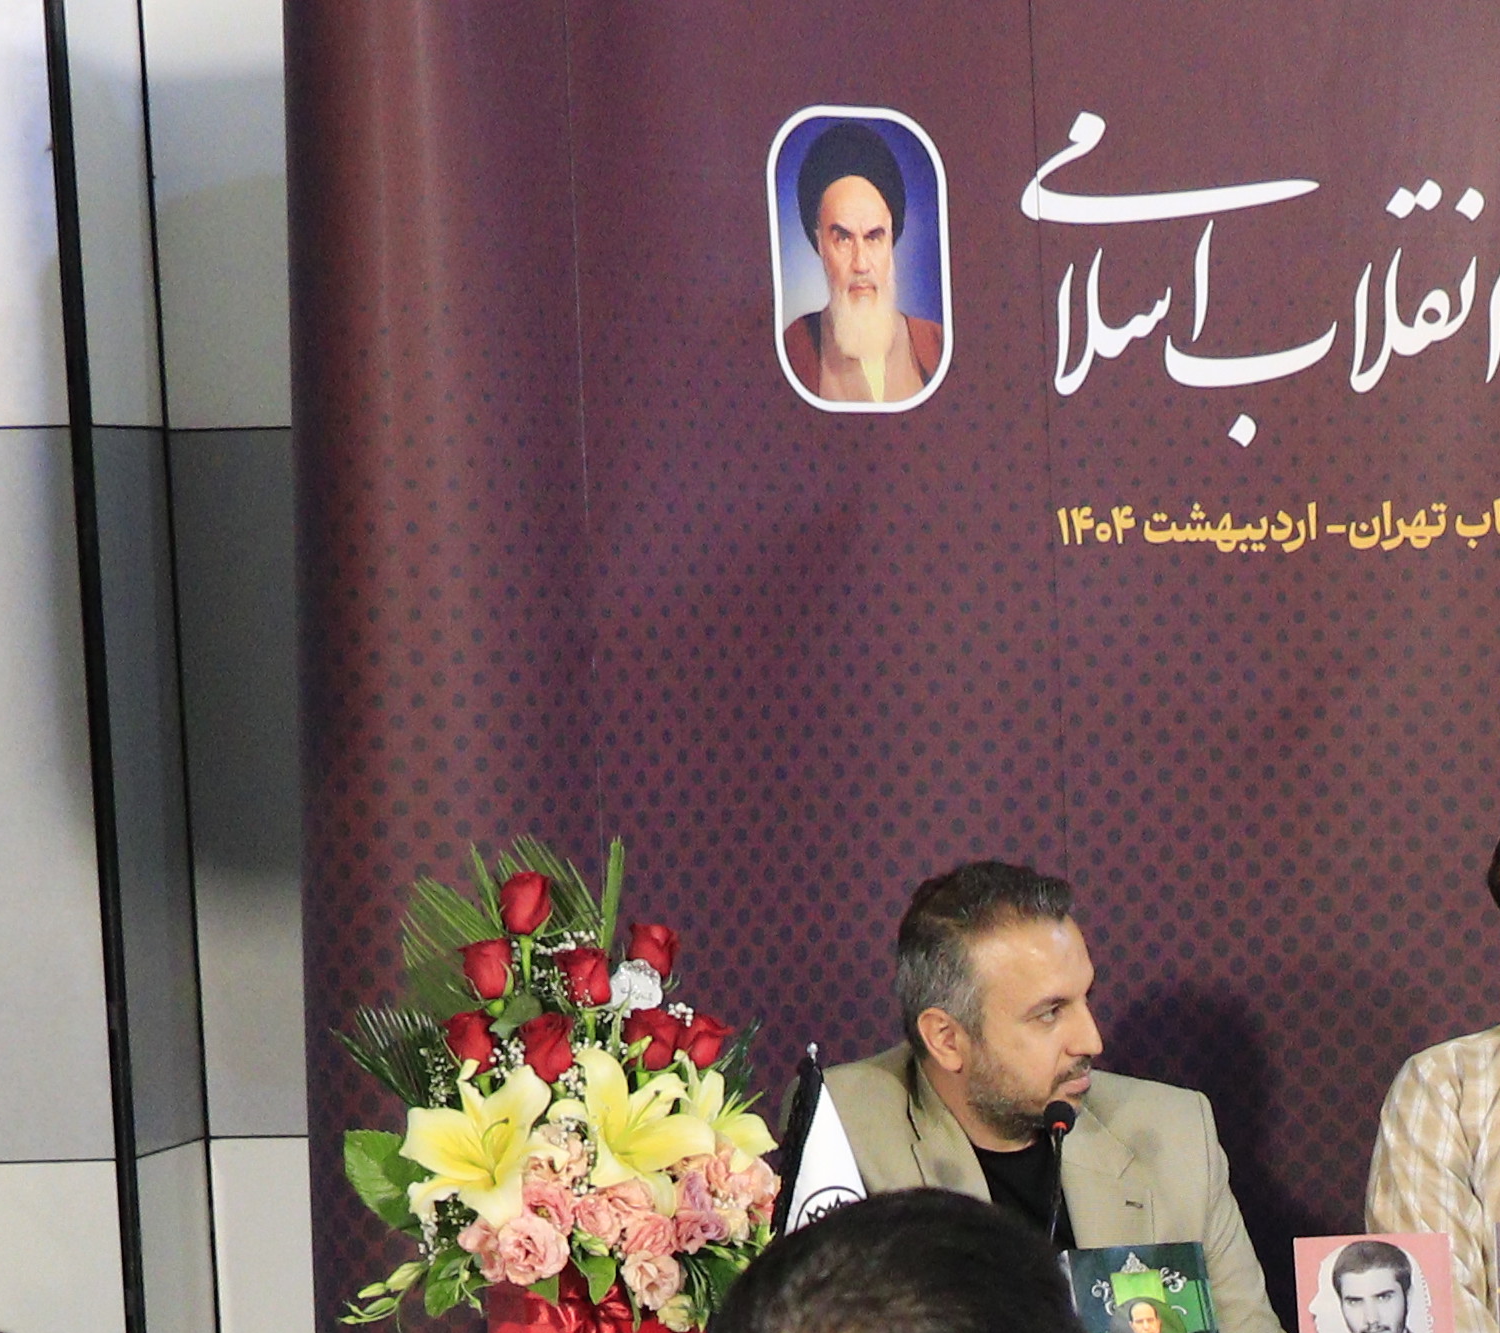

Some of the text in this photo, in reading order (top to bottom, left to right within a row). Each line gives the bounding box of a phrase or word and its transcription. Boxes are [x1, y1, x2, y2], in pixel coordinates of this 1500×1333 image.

[1020, 112, 1319, 395] اسلامی
[1056, 505, 1137, 544] ۱۴۰۴
[1143, 501, 1318, 553] اردیبهشت
